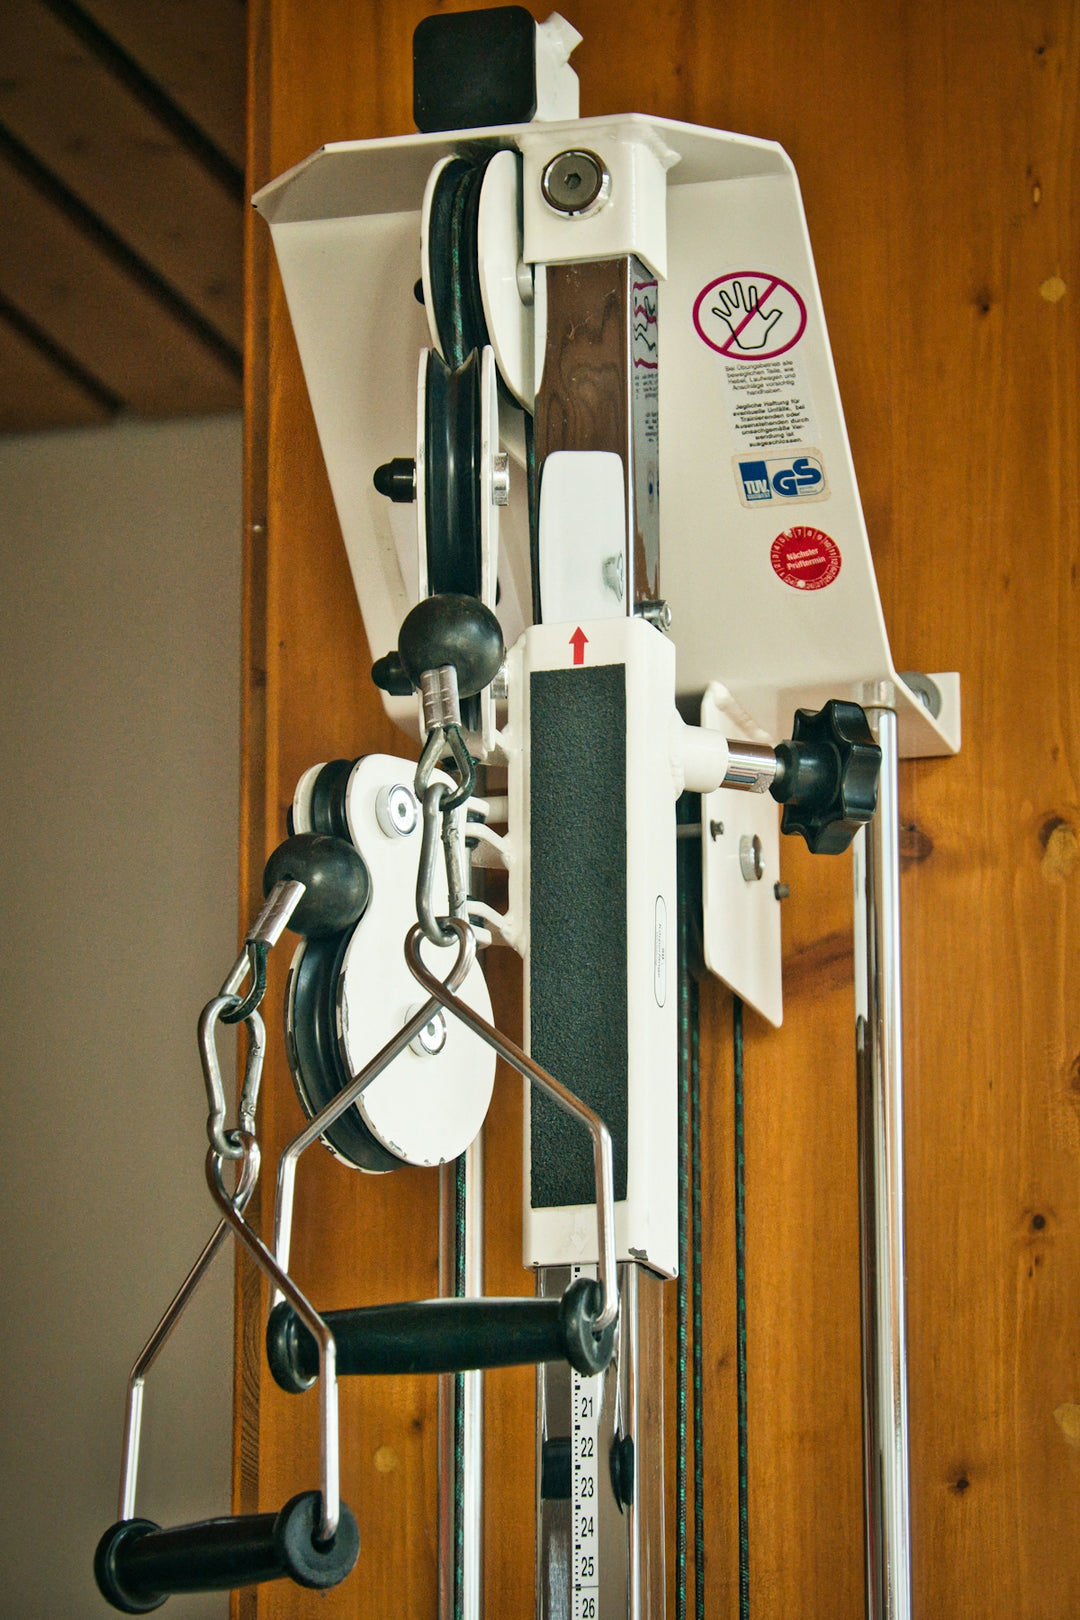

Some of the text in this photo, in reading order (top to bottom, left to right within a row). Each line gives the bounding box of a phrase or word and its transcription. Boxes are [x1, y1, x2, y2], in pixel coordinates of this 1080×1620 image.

[772, 458, 822, 496] GS
[786, 548, 819, 561] Nächster
[786, 556, 827, 570] Prüftermin
[581, 1397, 593, 1418] 21
[581, 1437, 594, 1458] 22
[581, 1477, 594, 1498] 23
[581, 1517, 594, 1538] 24
[581, 1556, 594, 1577] 25
[582, 1597, 595, 1619] 26
